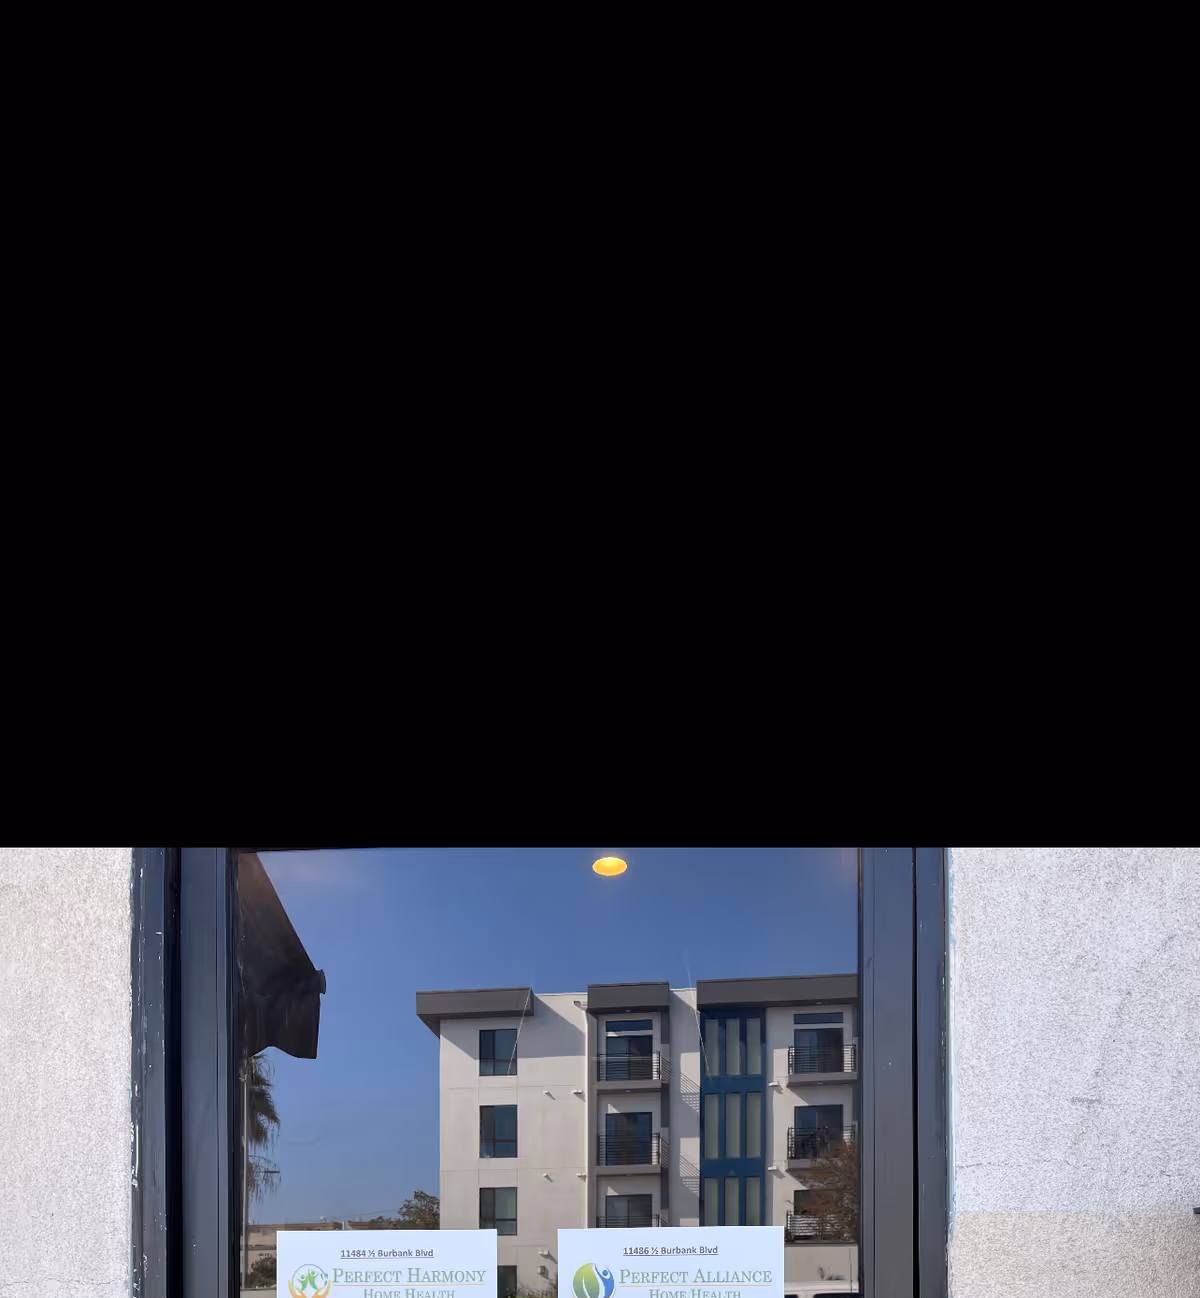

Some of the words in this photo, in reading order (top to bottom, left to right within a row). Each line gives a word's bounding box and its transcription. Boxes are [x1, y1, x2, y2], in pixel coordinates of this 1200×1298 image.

[341, 1249, 366, 1258] 11484
[378, 1249, 413, 1258] Burbank
[416, 1249, 434, 1258] Blvd
[623, 1246, 649, 1255] 11486
[662, 1246, 697, 1255] Burbank
[699, 1246, 718, 1255] Blvd
[332, 1268, 402, 1283] PERFECT
[407, 1268, 486, 1283] HARMONY
[620, 1269, 689, 1283] PERFECT
[692, 1269, 772, 1283] ALLIANCE
